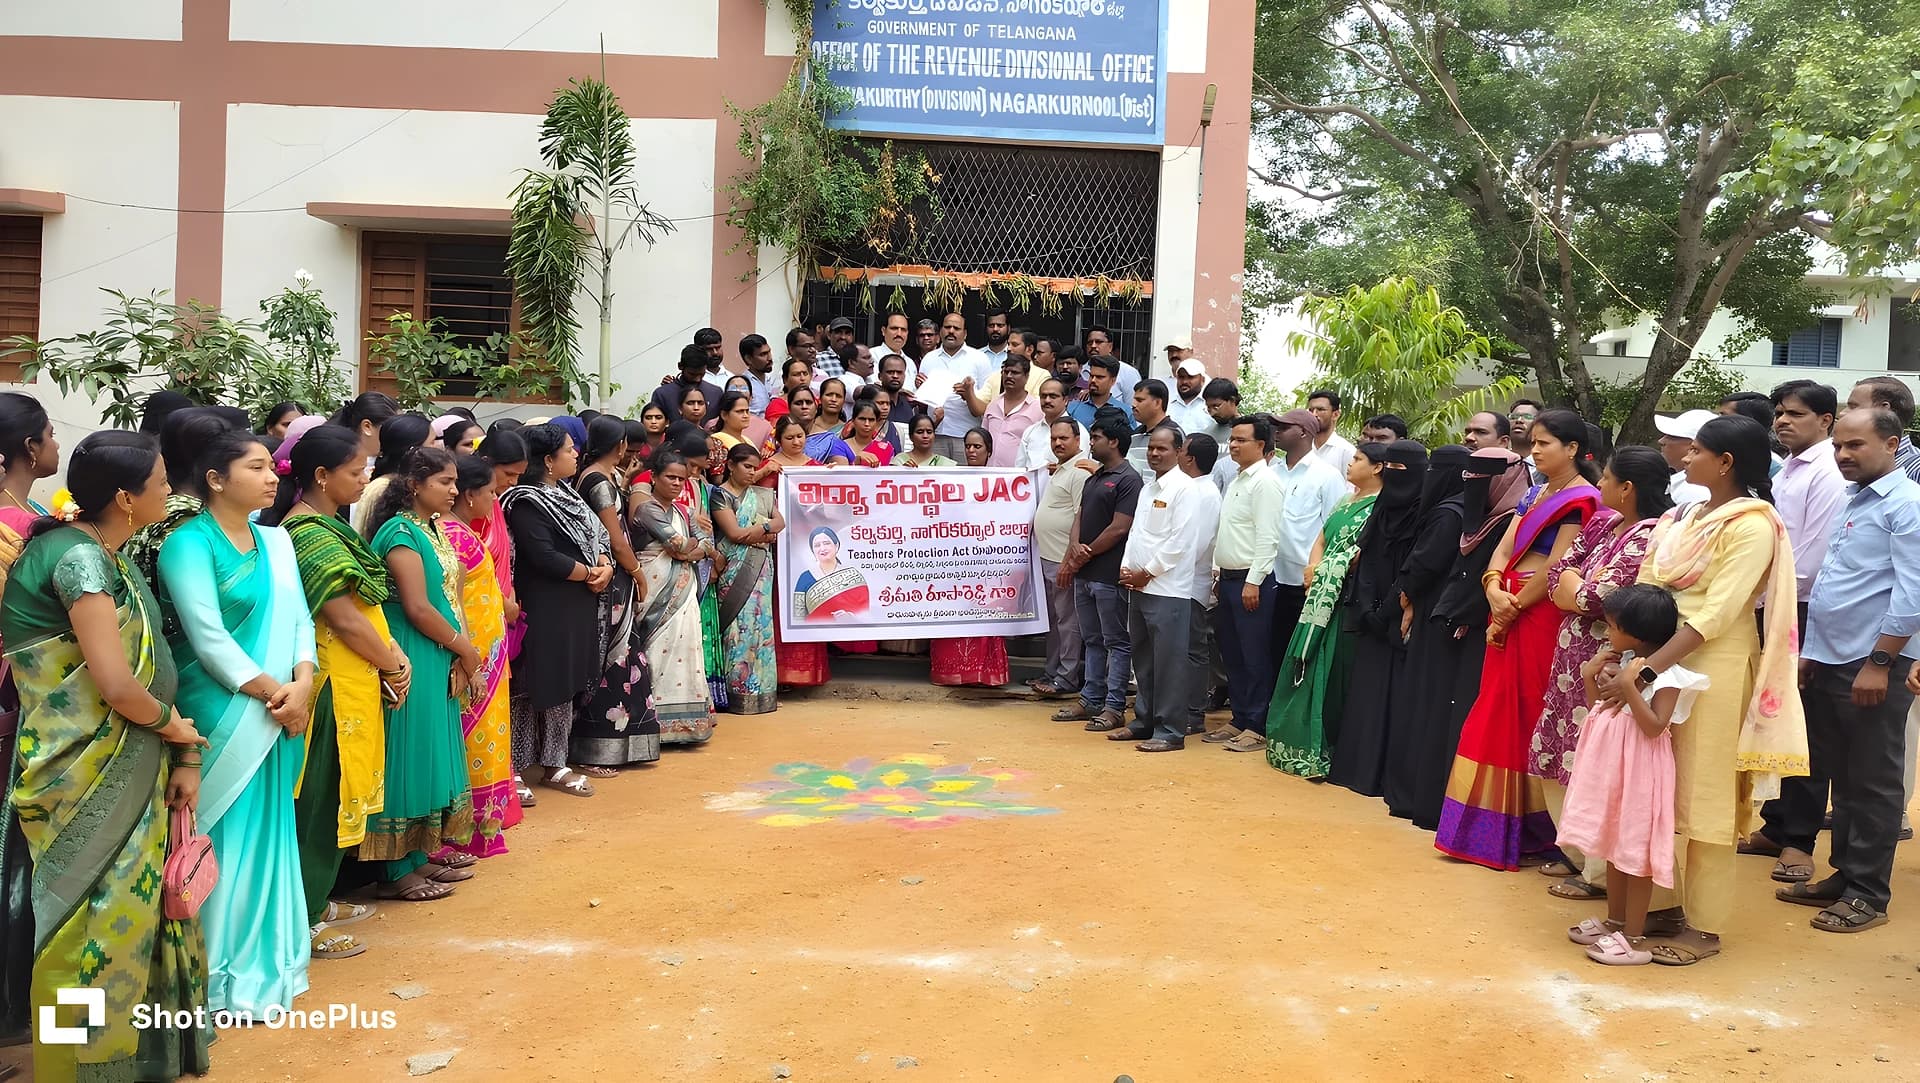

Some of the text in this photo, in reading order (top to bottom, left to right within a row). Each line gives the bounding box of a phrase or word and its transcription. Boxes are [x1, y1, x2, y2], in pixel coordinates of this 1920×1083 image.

[867, 20, 1077, 41] GOVERNMENT OF TELANGANA
[862, 42, 882, 73] OF
[886, 43, 921, 75] THE
[924, 45, 1002, 78] REVENUE
[1005, 48, 1094, 81] DIVISIONAL
[1102, 53, 1154, 84] OFFICE
[798, 475, 1031, 518] విద్యా సంస్థల JAC
[848, 549, 894, 560] Teachers
[897, 547, 949, 559] Protection
[952, 546, 970, 557] Act
[879, 585, 923, 607] శ్రీమతి
